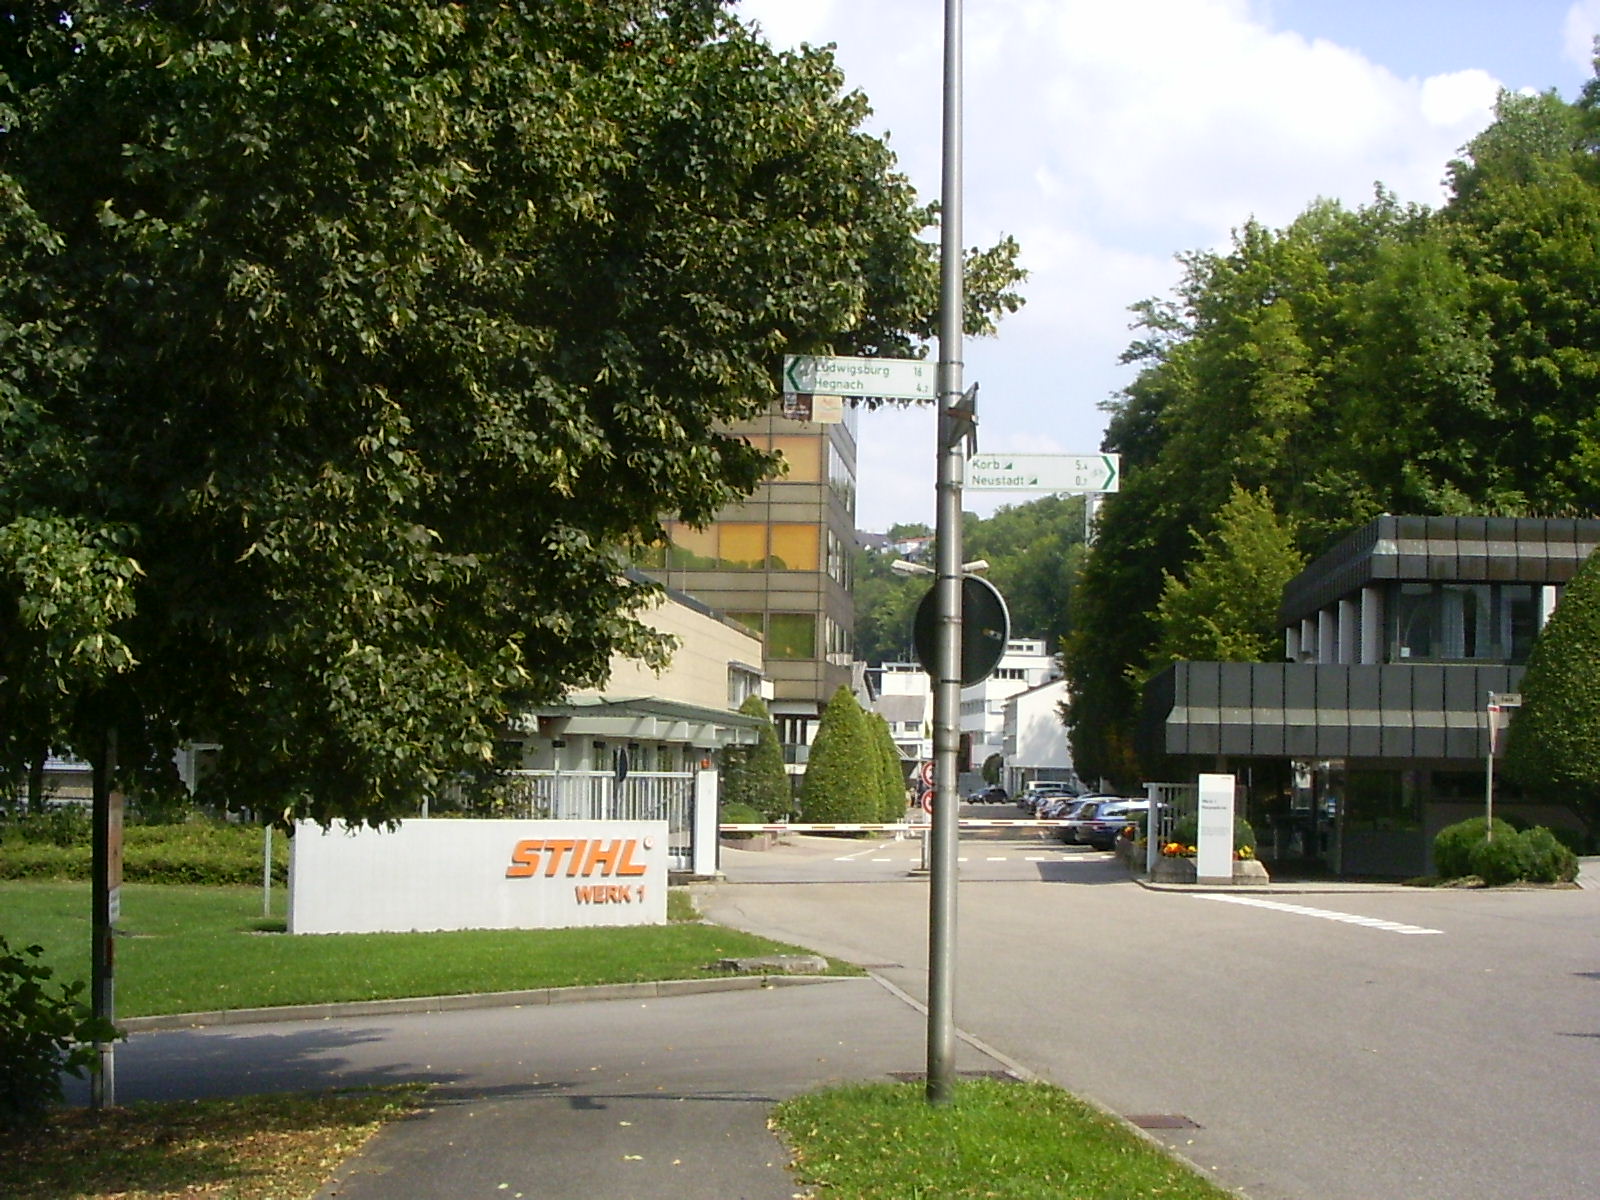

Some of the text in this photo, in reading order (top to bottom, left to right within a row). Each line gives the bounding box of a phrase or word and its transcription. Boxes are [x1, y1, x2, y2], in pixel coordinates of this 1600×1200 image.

[814, 363, 890, 378] Ludwigsburg
[814, 378, 864, 391] Hegnach
[972, 459, 1000, 470] Korb
[972, 475, 1024, 486] Neustadt
[505, 840, 646, 878] STIHL
[575, 885, 645, 905] WERK 1
